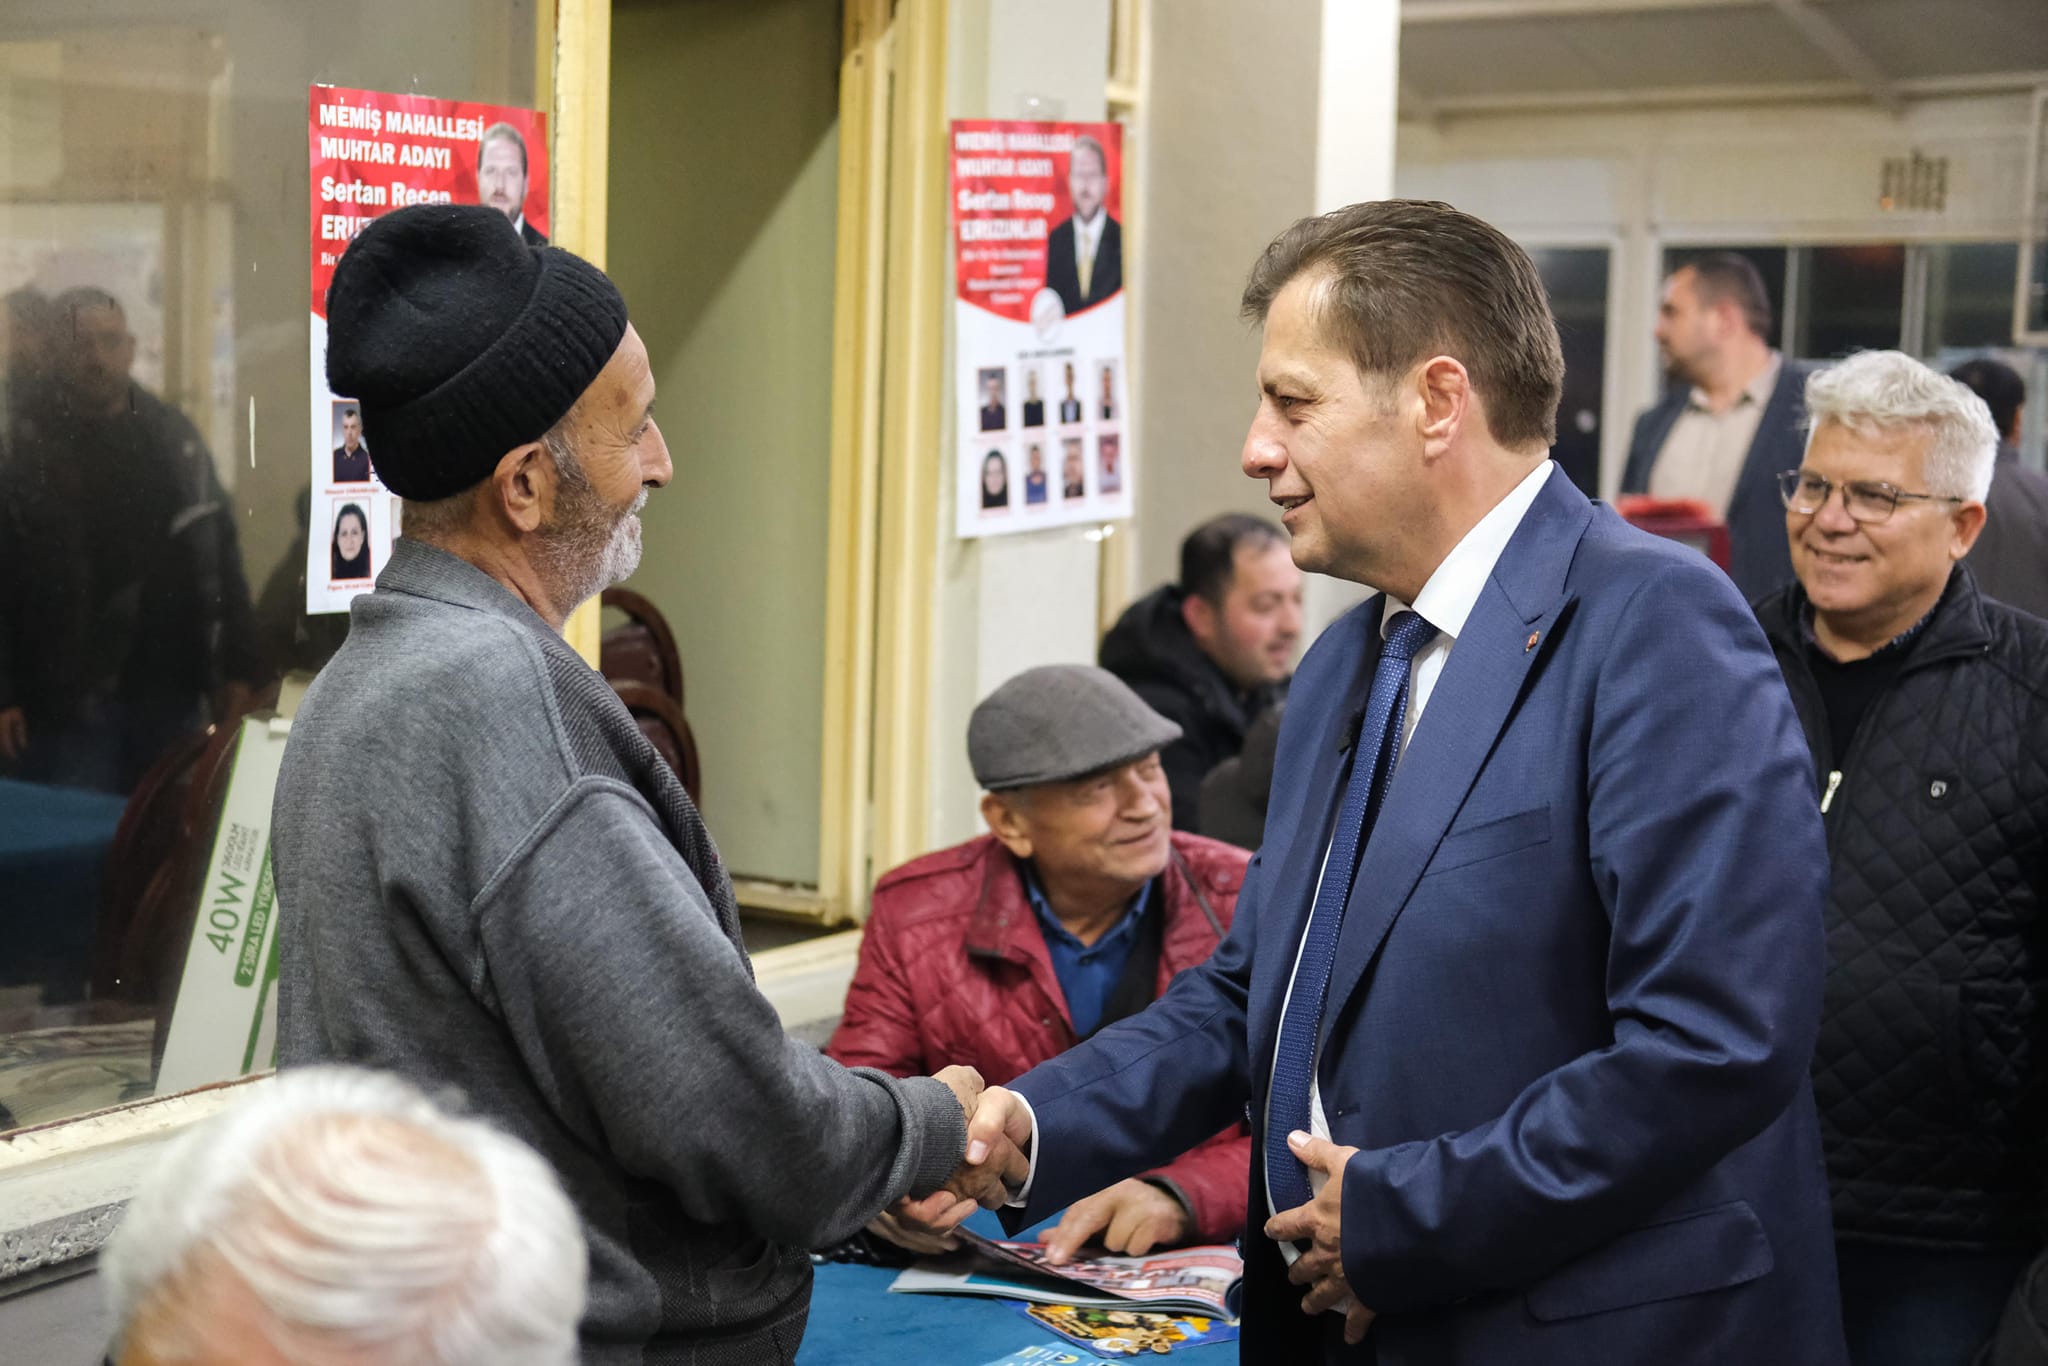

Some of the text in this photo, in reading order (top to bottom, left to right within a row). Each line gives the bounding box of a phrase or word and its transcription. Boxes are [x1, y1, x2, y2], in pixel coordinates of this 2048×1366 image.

[385, 111, 484, 142] MAHALLESİ
[320, 137, 452, 170] MUHTAR ADAYI
[321, 175, 387, 206] Sertan
[321, 252, 336, 267] Bir
[206, 871, 246, 955] 40W
[251, 911, 266, 935] LED
